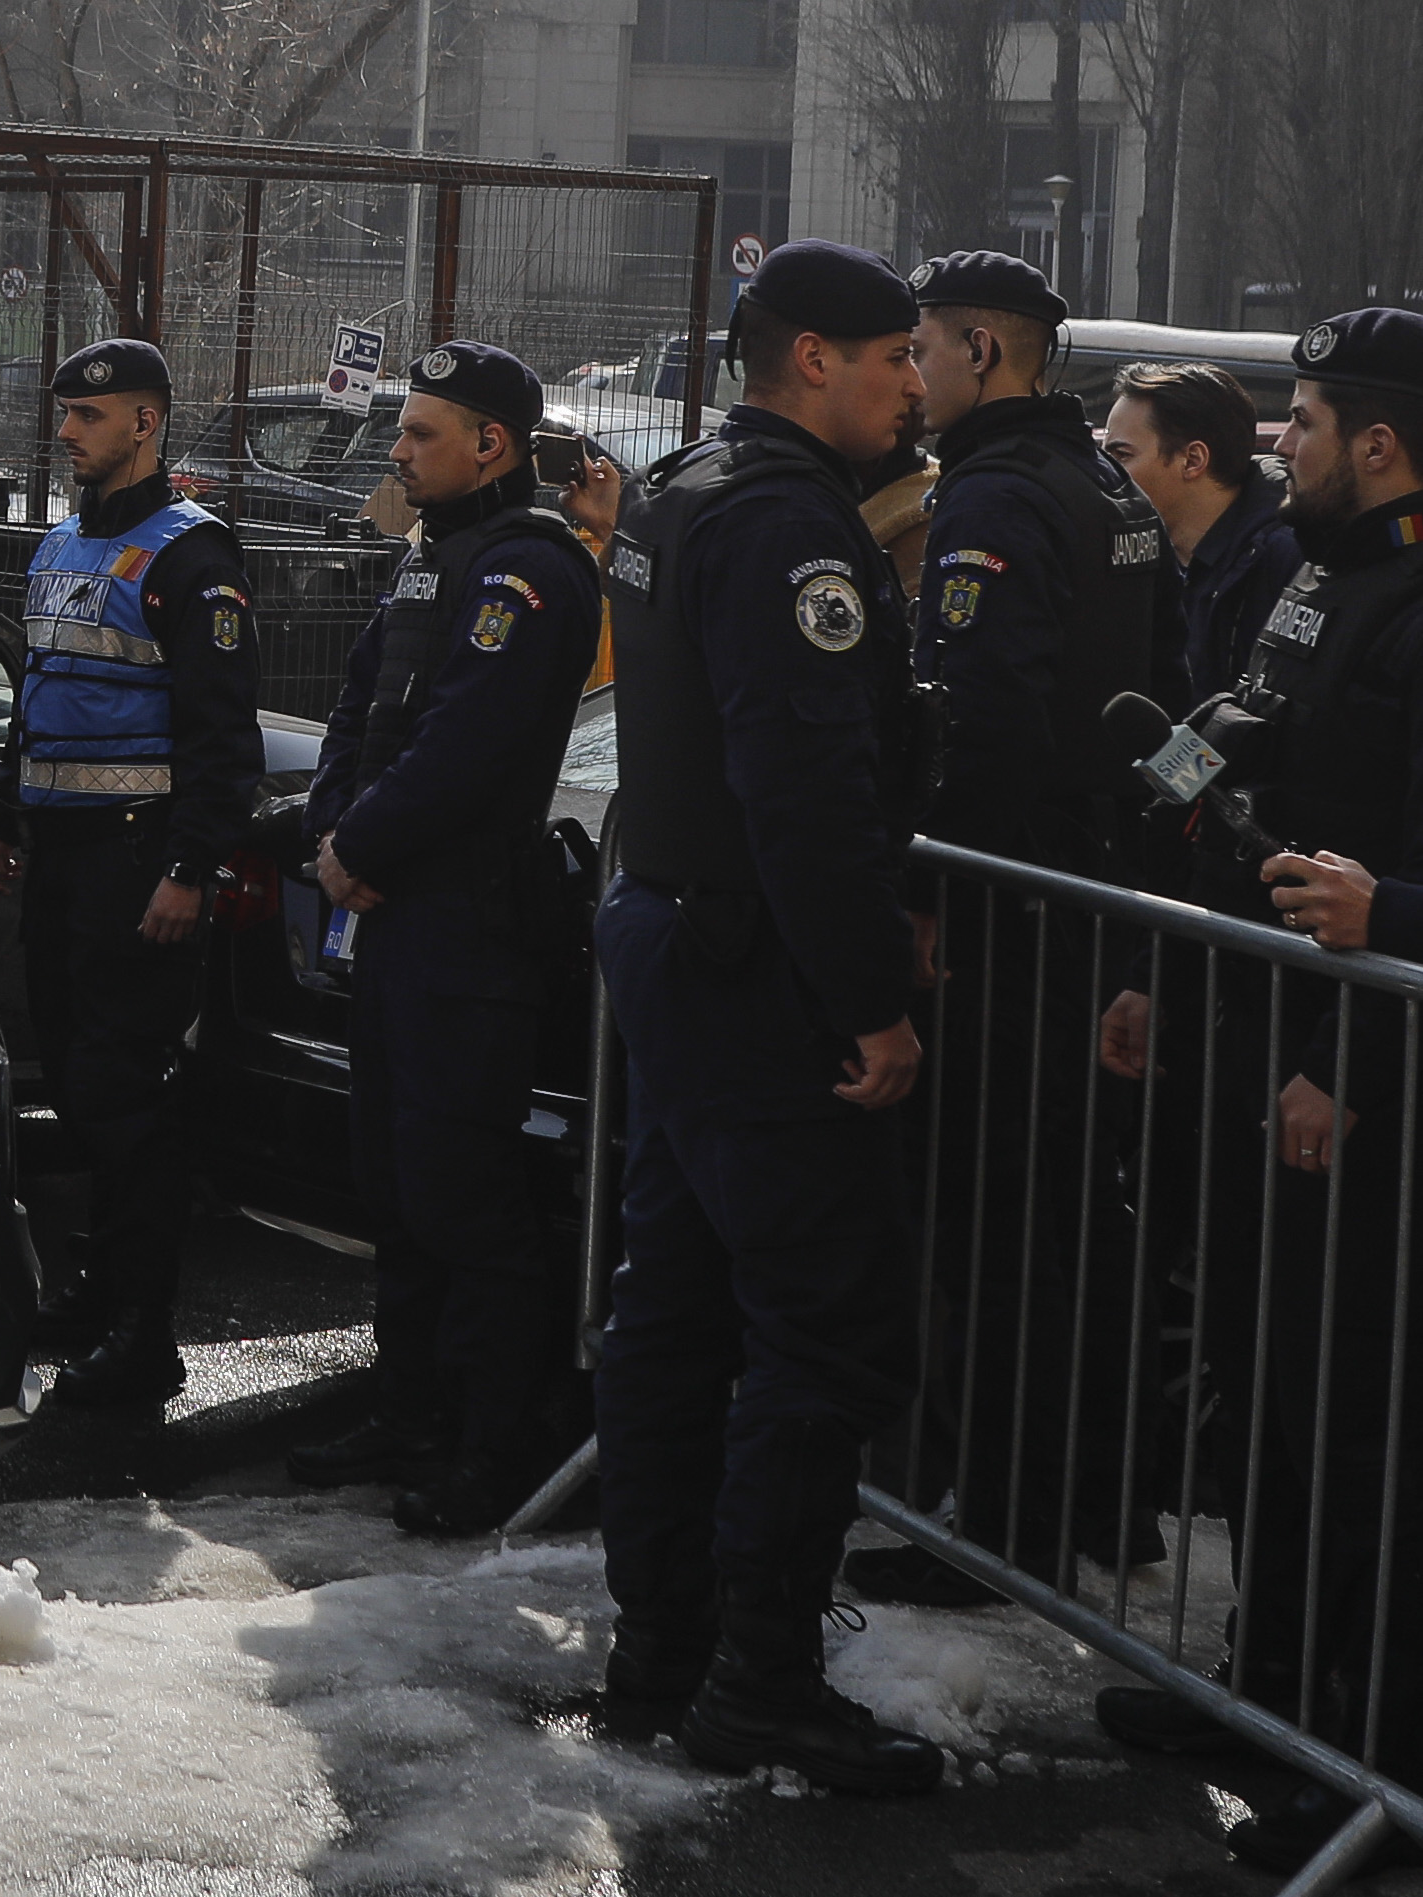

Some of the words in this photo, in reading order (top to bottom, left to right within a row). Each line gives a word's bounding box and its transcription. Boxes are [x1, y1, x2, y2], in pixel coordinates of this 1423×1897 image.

[338, 333, 353, 359] P
[202, 585, 247, 607] RONIA
[483, 573, 541, 610] ROMANIA
[325, 930, 342, 950] RO
